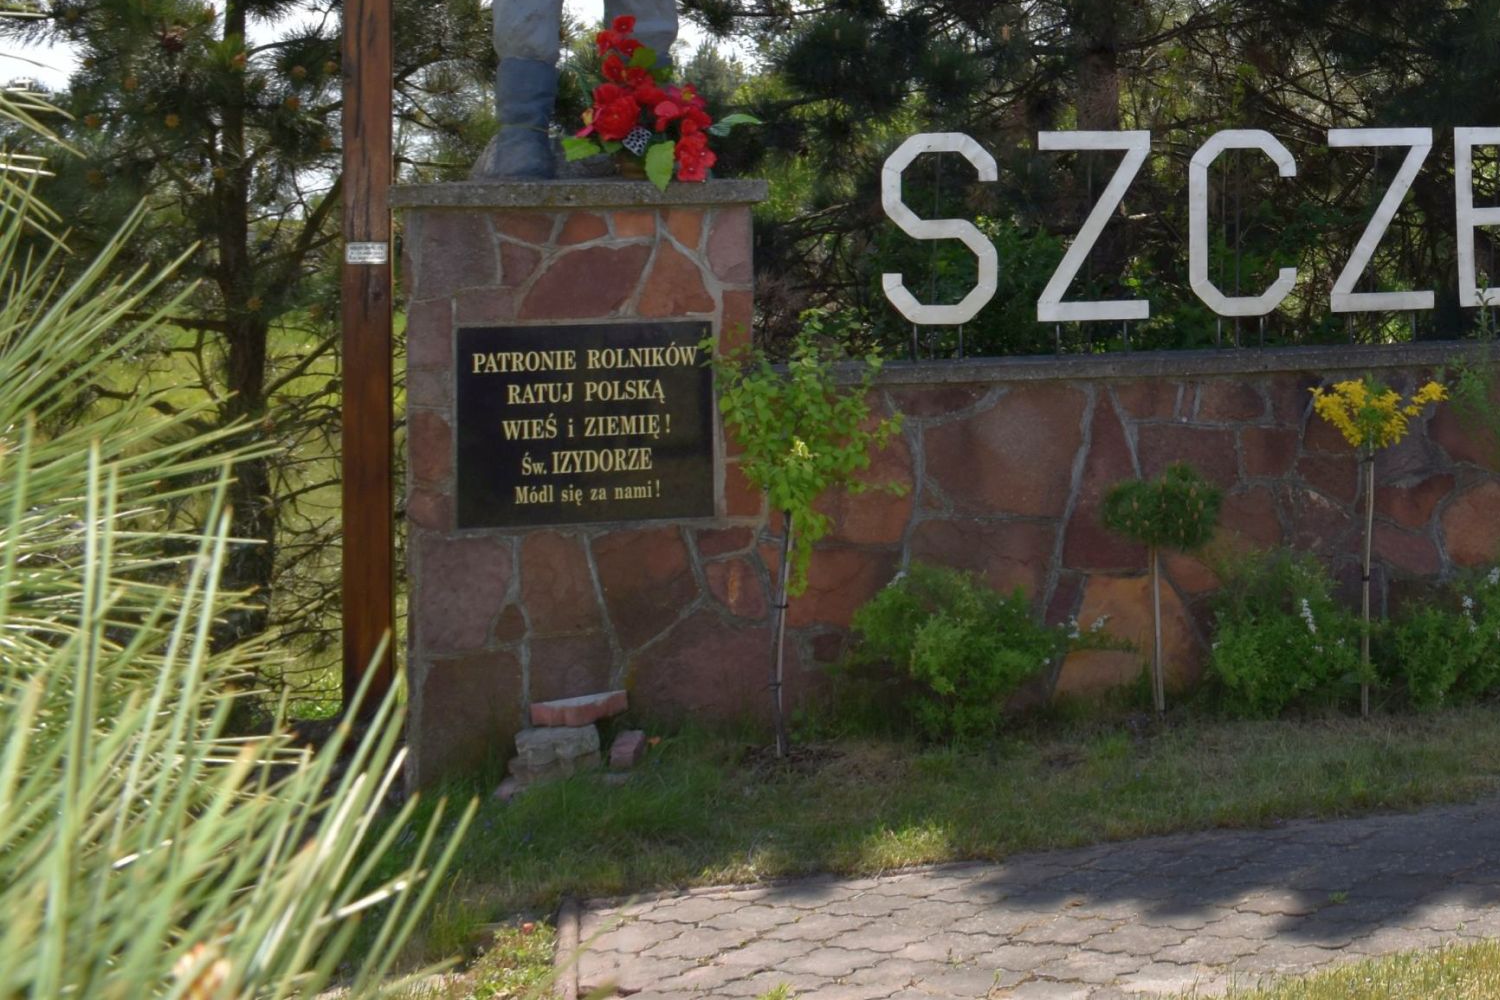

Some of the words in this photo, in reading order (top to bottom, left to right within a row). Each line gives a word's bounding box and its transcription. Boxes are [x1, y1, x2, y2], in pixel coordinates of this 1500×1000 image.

[472, 350, 576, 374] PATRONIE
[587, 341, 698, 369] ROLNIKÓW
[507, 382, 573, 405] RATUJ
[584, 379, 666, 404] POLSKĄ
[502, 413, 558, 440] WIEŚ
[568, 418, 575, 438] i
[521, 452, 547, 475] Św.
[551, 448, 652, 474] IZYDORZE
[515, 485, 554, 504] Módl
[561, 484, 583, 506] się
[590, 486, 607, 500] za
